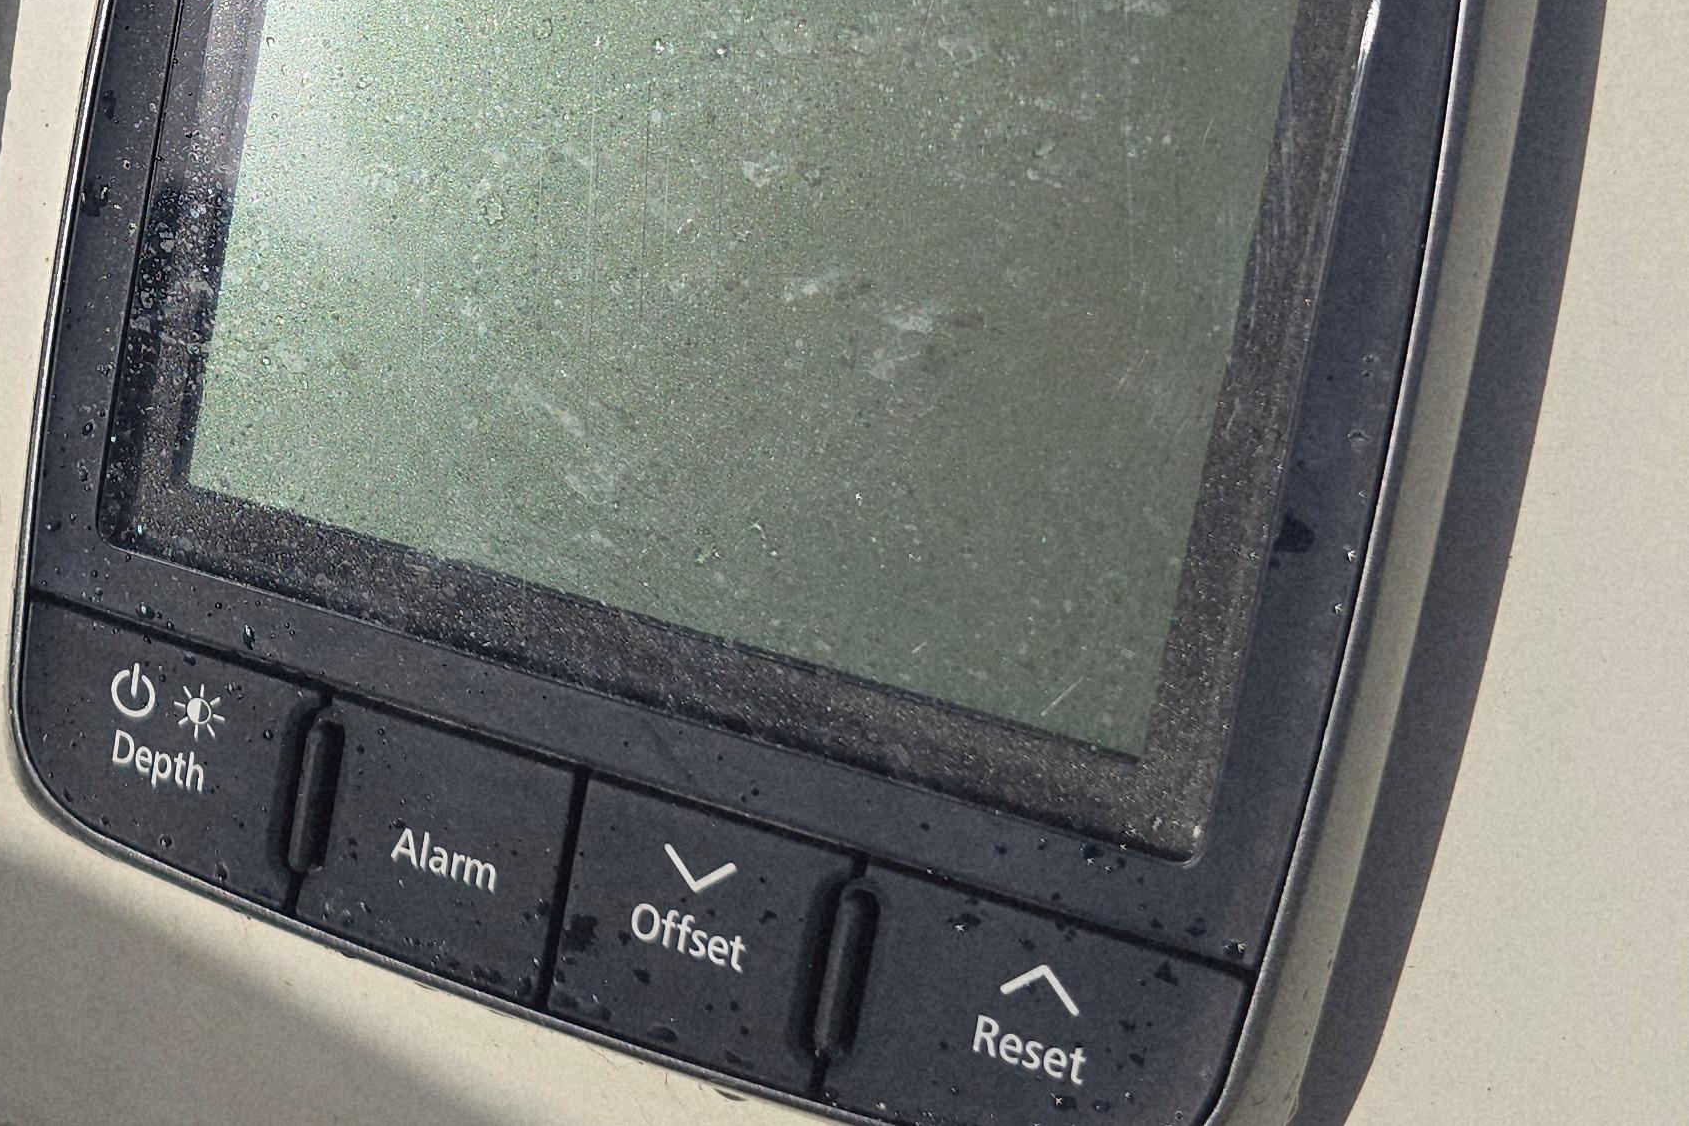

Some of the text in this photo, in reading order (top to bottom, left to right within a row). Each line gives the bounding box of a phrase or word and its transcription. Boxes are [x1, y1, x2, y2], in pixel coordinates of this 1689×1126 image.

[112, 729, 205, 793] Depth
[390, 827, 498, 894] Alarm
[630, 902, 747, 973] Offset
[972, 1014, 1087, 1086] Reset
